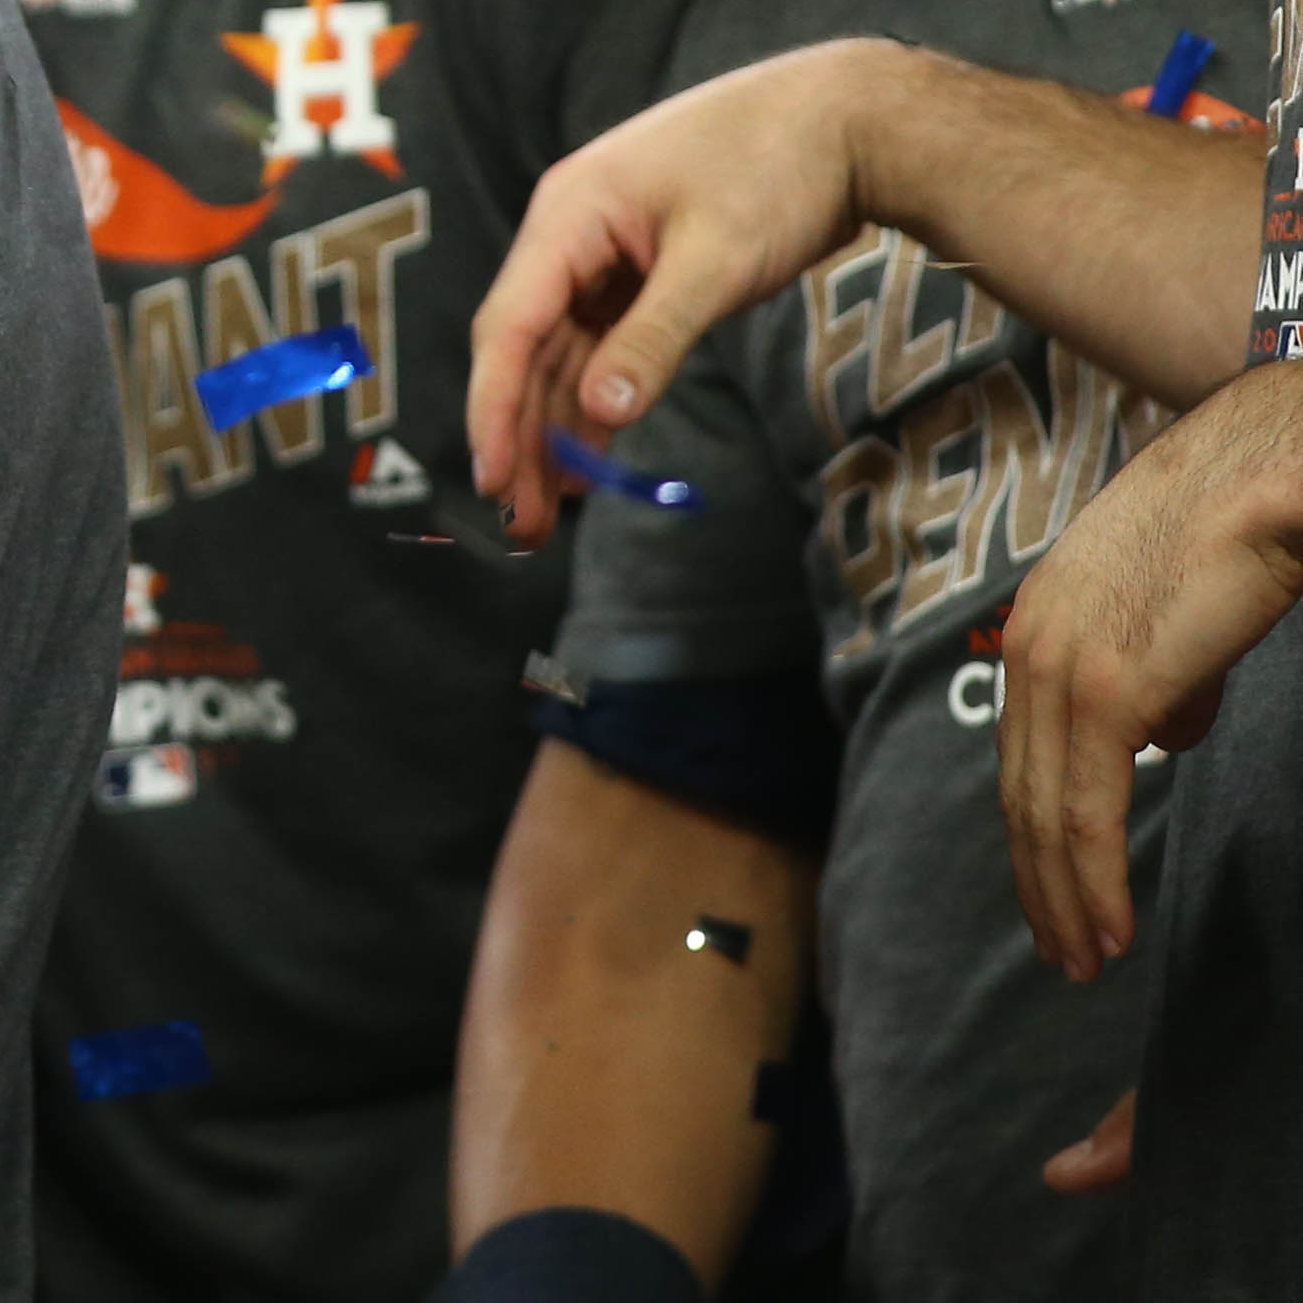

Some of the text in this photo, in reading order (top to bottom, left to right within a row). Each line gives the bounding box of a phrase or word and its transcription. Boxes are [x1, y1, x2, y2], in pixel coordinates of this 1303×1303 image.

[261, 0, 396, 159] H
[99, 187, 432, 519] ANT
[1254, 250, 1303, 313] AMP
